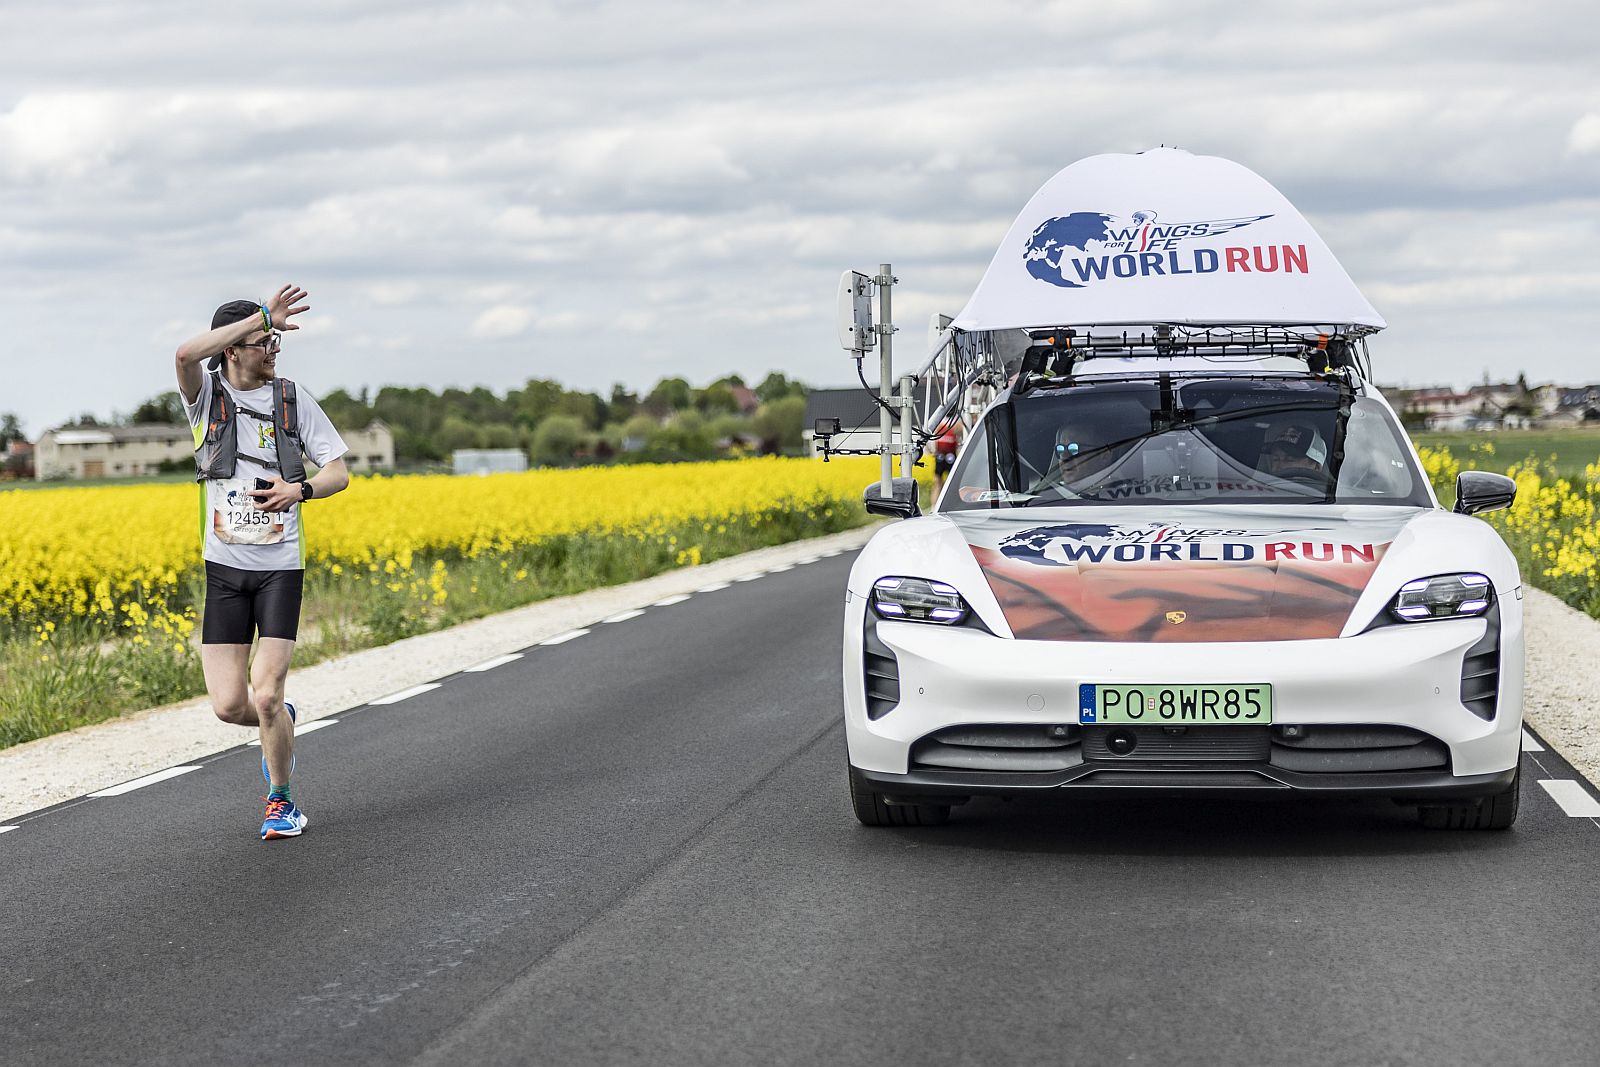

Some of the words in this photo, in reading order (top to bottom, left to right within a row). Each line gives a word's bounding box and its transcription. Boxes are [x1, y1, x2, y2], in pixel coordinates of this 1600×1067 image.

[1108, 223, 1211, 242] WINGS
[1103, 241, 1125, 249] FOR
[1123, 237, 1182, 254] LIFE
[1071, 248, 1219, 283] WORLD
[1225, 244, 1309, 274] RUN
[227, 511, 270, 525] 12455
[276, 512, 281, 522] 1
[1117, 528, 1247, 537] WINGS
[1132, 535, 1209, 543] LIFE
[1060, 542, 1255, 563] WORLD
[1264, 542, 1375, 563] RUN
[1082, 708, 1095, 717] PL
[1102, 688, 1144, 720] PO
[1159, 688, 1261, 720] 8WR85
